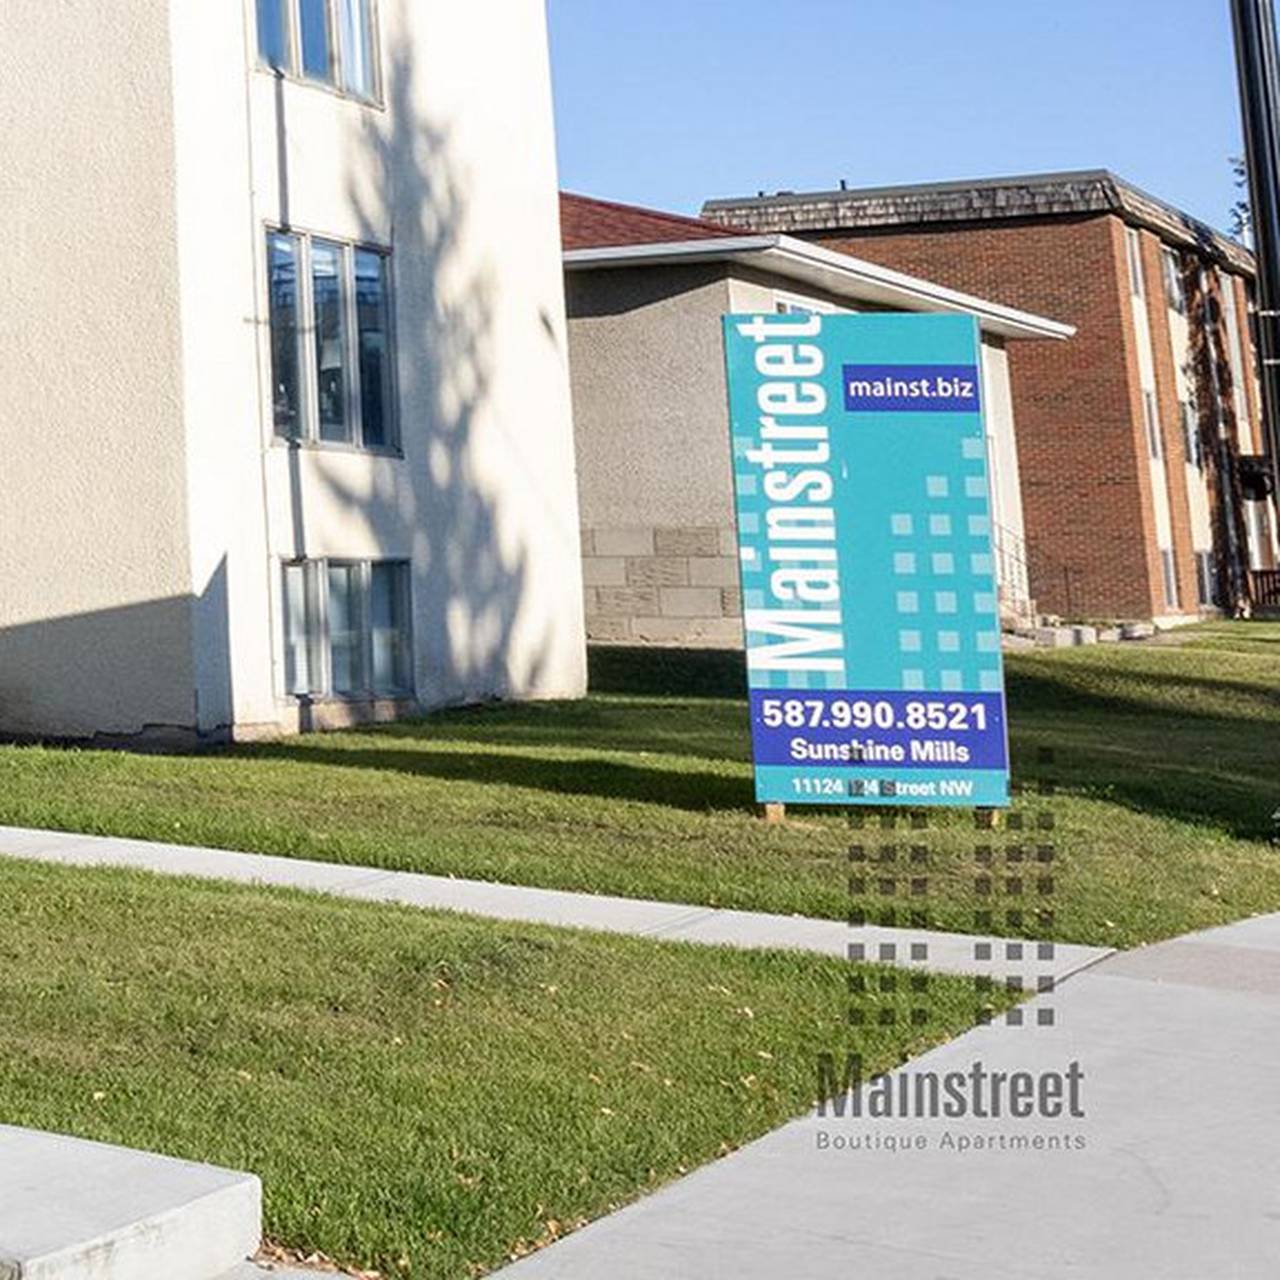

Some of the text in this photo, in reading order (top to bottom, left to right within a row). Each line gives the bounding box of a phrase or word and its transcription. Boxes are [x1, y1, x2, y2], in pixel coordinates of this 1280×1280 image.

[849, 376, 974, 398] mainst.biz
[736, 315, 846, 671] Mainstreet
[762, 699, 987, 731] 587.990.8521
[790, 737, 970, 763] Sunshine Mills
[792, 777, 844, 795] 11124
[882, 780, 937, 797] Street
[939, 779, 974, 797] NW
